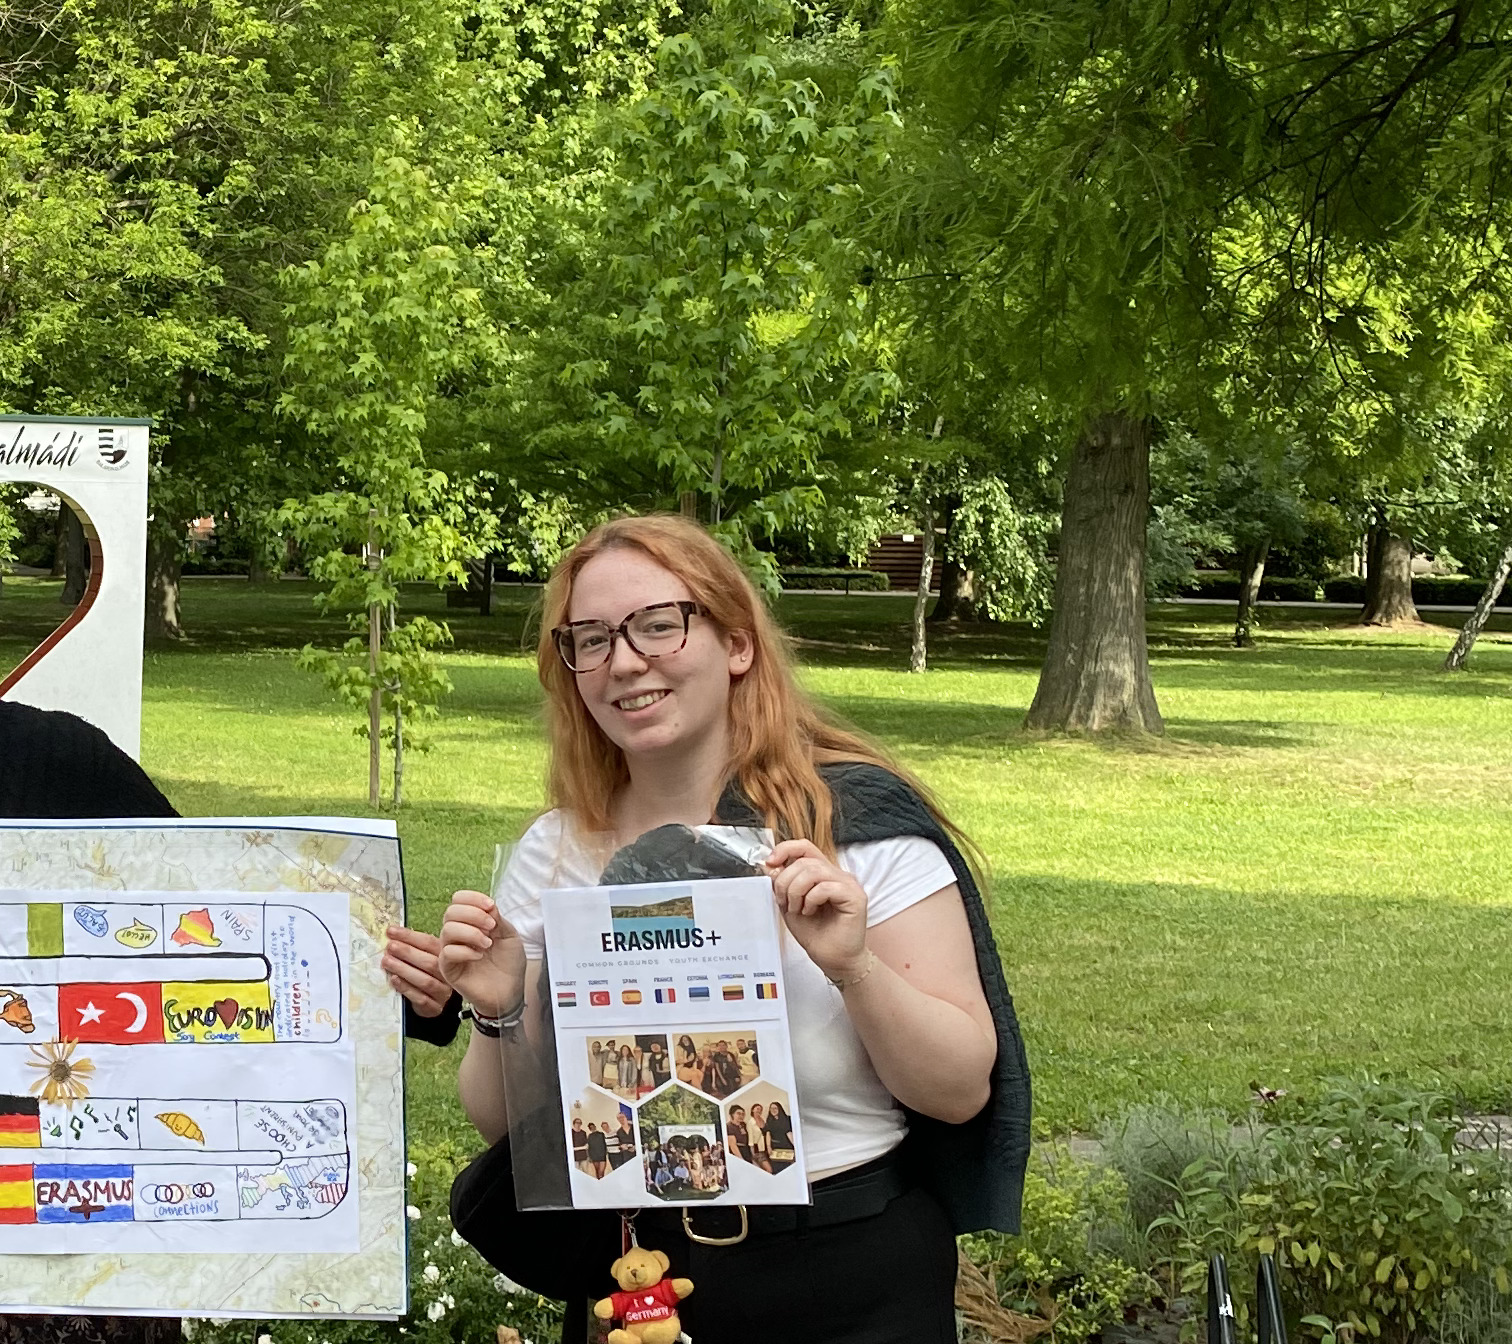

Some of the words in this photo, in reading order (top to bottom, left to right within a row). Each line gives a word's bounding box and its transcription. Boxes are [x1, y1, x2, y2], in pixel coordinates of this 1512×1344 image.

[219, 908, 255, 942] SPAIN
[601, 927, 722, 953] ERASMUS+
[575, 961, 614, 969] COMMON
[617, 959, 660, 967] GROUNDS
[702, 954, 749, 963] EXCHANGE
[291, 982, 302, 1036] children
[253, 1118, 297, 1153] CHOOSE
[37, 1179, 133, 1206] ERASMUS
